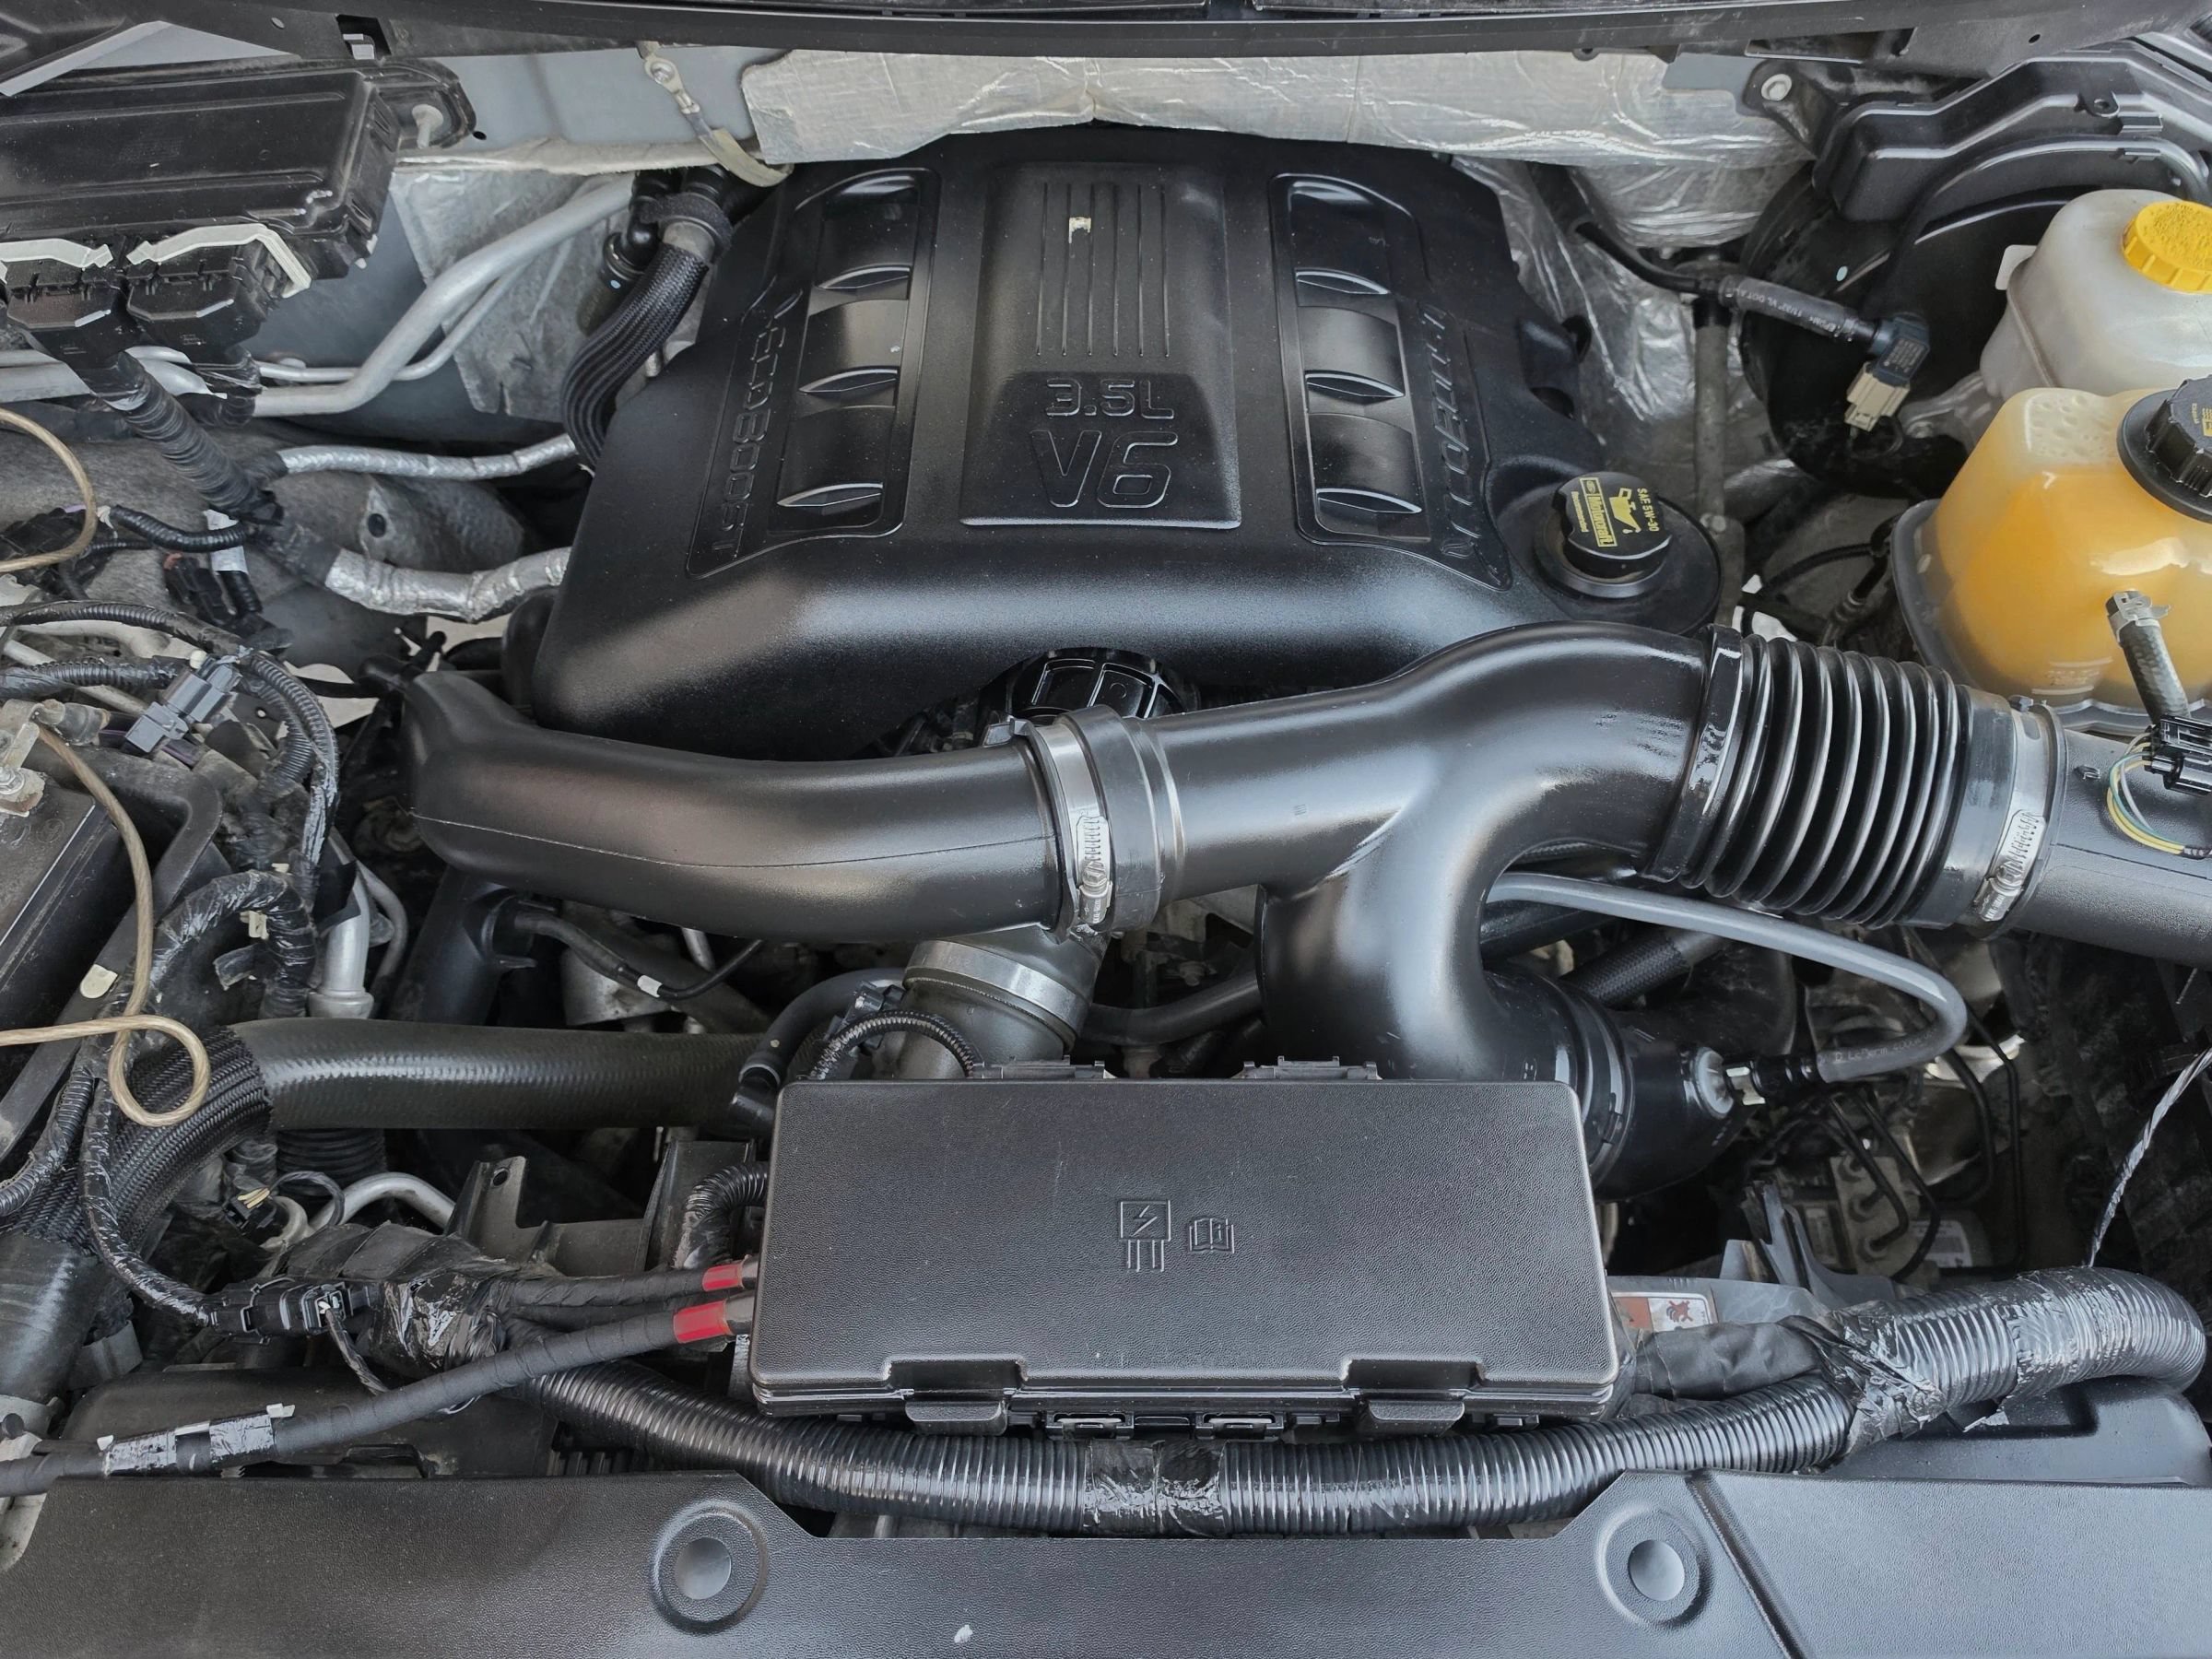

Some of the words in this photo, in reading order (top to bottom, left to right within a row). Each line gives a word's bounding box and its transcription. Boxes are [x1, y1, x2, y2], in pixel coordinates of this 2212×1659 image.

[1045, 378, 1175, 419] 3.5L
[1030, 429, 1179, 508] V6
[1637, 488, 1652, 505] SAE
[1587, 496, 1614, 544] Motorcraft
[1642, 504, 1660, 532] 5W-30
